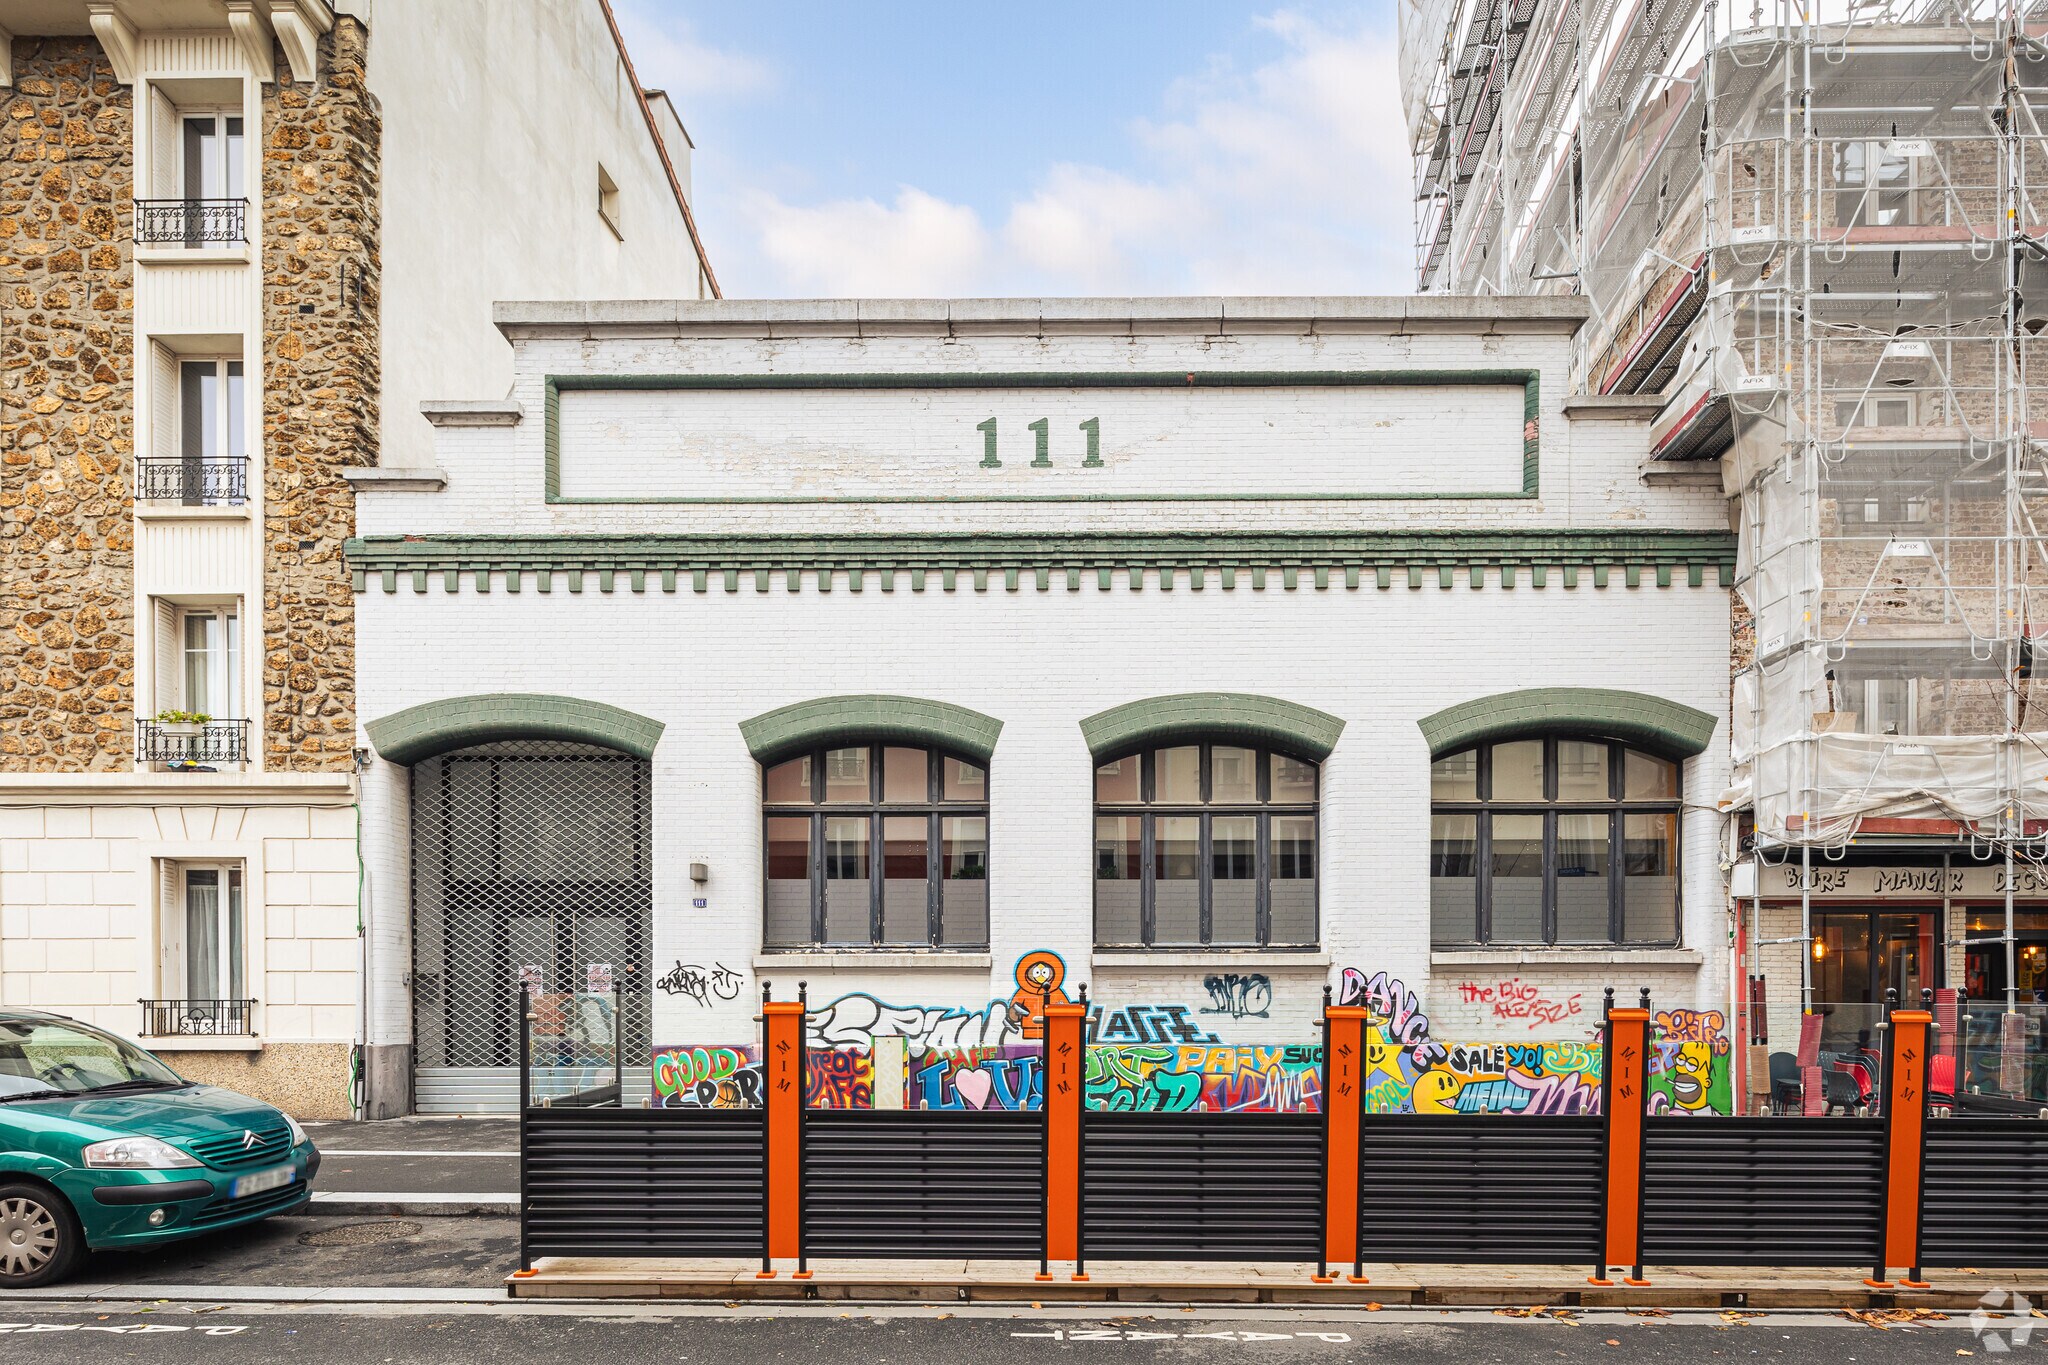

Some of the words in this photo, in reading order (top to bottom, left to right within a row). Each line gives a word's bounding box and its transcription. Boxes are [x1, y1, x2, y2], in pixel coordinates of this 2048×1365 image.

[976, 416, 1105, 469] 111
[1874, 868, 1964, 893] MANGR
[653, 1048, 739, 1097] GOOD
